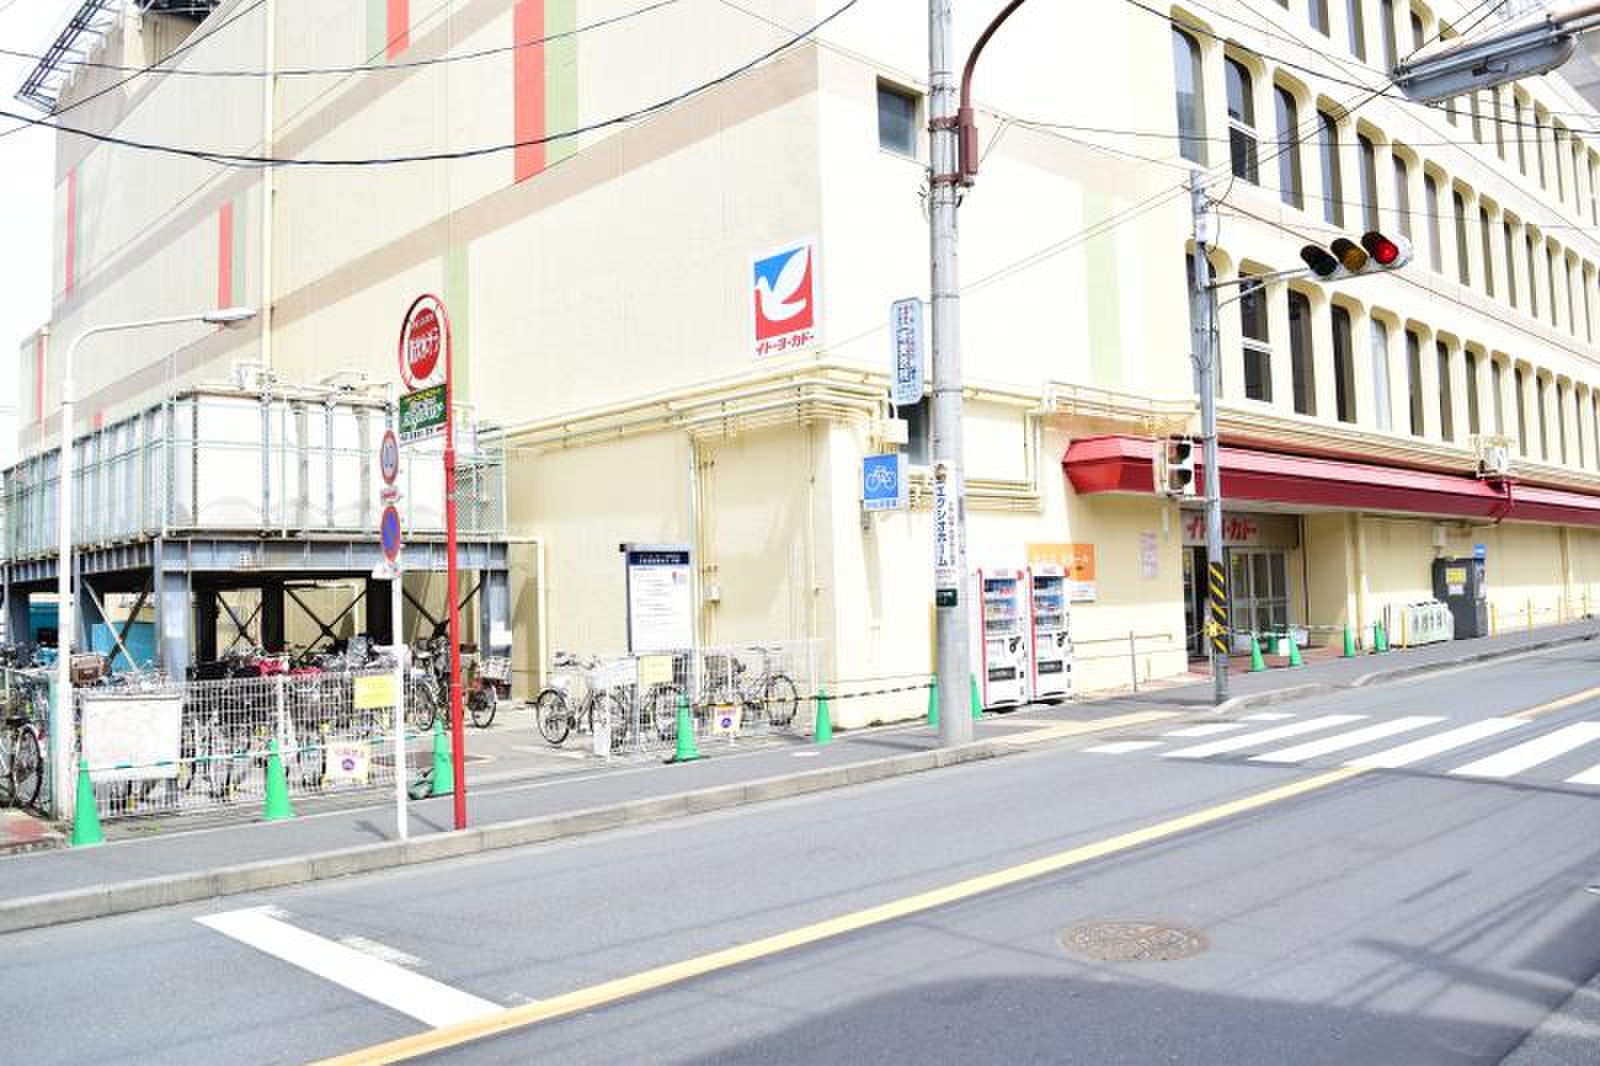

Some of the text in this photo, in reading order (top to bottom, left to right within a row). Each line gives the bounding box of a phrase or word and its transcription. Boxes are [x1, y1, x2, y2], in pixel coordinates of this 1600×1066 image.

[755, 331, 814, 356] イトーヨーカドー
[1187, 514, 1257, 540] イトーカドー
